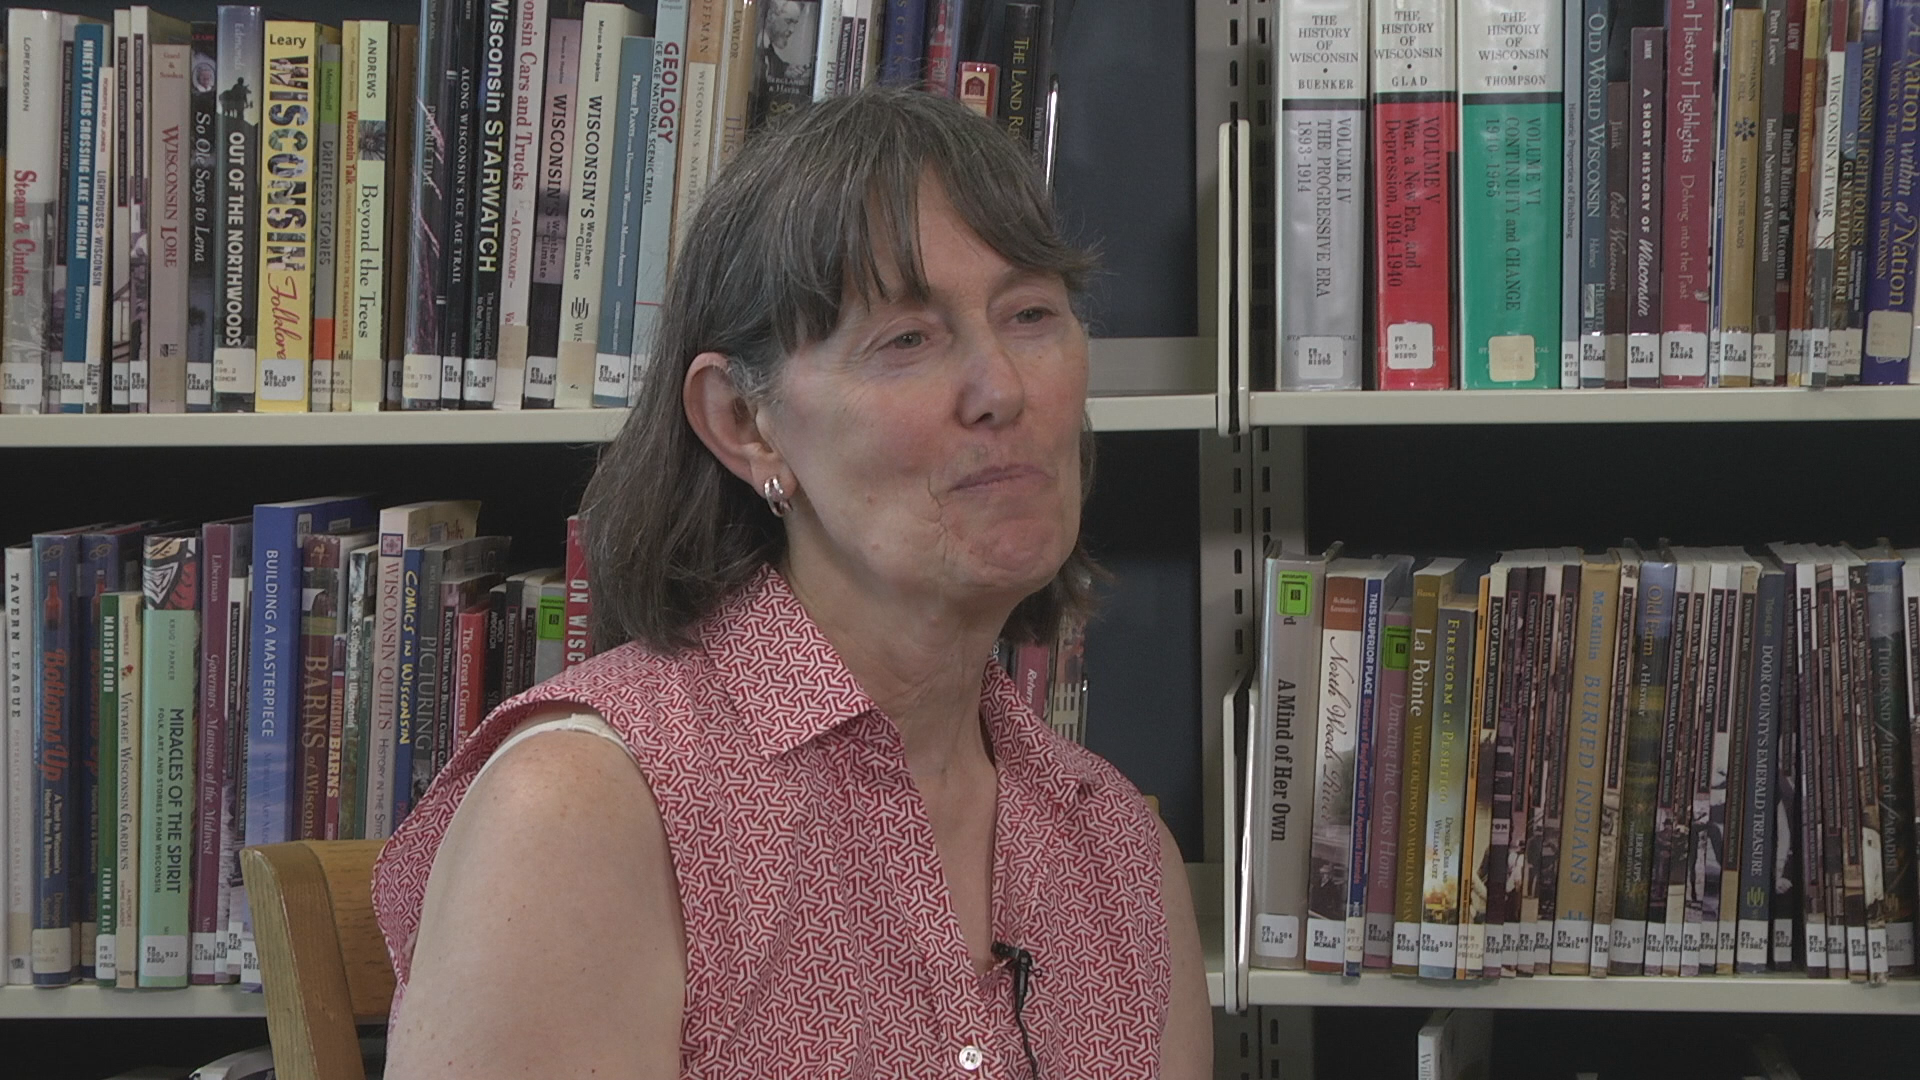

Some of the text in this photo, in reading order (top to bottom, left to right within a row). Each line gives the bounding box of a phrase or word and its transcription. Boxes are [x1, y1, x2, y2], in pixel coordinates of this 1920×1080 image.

[270, 34, 307, 46] Leary
[1289, 53, 1359, 63] WISCONSIN
[1298, 28, 1351, 38] HISTORY
[1311, 15, 1337, 26] THE
[1316, 40, 1333, 50] OF
[1374, 48, 1443, 59] WISCONSIN
[1381, 23, 1434, 34] HISTORY
[1394, 11, 1420, 21] THE
[1399, 36, 1417, 46] OF
[1478, 49, 1549, 60] WISCONSIN
[1487, 24, 1540, 35] HISTORY
[1500, 12, 1527, 23] THE
[1505, 37, 1522, 47] OF
[22, 37, 32, 112] LORENZSONN
[366, 38, 377, 99] ANDREWS
[657, 42, 679, 143] GEOLOGY
[1298, 79, 1354, 89] BUENKER
[1391, 76, 1427, 87] GLAD
[1485, 75, 1546, 86] THOMPSON
[1587, 13, 1606, 217] OLD WORLD WISCONSIN
[75, 40, 95, 259] NINETY YEARS CROSSING LAKE MICHIGAN
[266, 56, 309, 272] WISCONSIN
[512, 51, 537, 190] Cars and Trucks
[580, 95, 602, 218] WISCONSIN'S
[1297, 120, 1312, 193] 1893-1914
[1336, 118, 1351, 204] VOLUME IV
[1422, 116, 1440, 204] VOLUME V
[1525, 117, 1541, 205] VOLUME VI
[1677, 13, 1701, 300] History Highlights Delving into the Past
[1822, 75, 1841, 218] WISCONSIN AT WAR
[161, 125, 179, 267] WISCONSIN LORE
[192, 112, 211, 262] So Ole Says to Lena
[452, 67, 470, 284] ALONG WISCONSIN'S ICE AGE TRAIL
[479, 120, 504, 272] STARWATCH
[1315, 119, 1332, 298] THE PROGRESSIVE ERA
[1382, 119, 1402, 287] Depression, 1914-1940
[1402, 118, 1420, 269] War, a New Era, and
[1504, 116, 1521, 311] CONTINUITY and CHANGE
[1637, 89, 1653, 317] A SHORT HISTORY OF Wisconsin
[11, 170, 37, 296] Steam & Cinders
[226, 132, 244, 346] OUT OF THE NORTHWOODS
[357, 185, 379, 338] Beyond the Trees
[574, 236, 584, 281] Climate
[584, 222, 595, 266] Weather
[74, 286, 84, 320] Brown
[268, 273, 302, 360] Folklore
[211, 554, 222, 602] Liberman
[264, 550, 278, 620] BUILDING
[1588, 591, 1605, 660] McMillin
[9, 573, 21, 718] TAVERN LEAGUE
[104, 616, 114, 692] MADISON FOOD
[263, 624, 276, 635] A
[378, 562, 398, 730] WISCONSIN QUILTS
[399, 570, 417, 744] COMICS IN WISCONSIN
[458, 627, 474, 727] The Great Circus
[1363, 593, 1377, 694] THIS SUPERIOR PLACE
[1410, 628, 1432, 716] La Pointe
[37, 648, 70, 781] Bottoms Up
[261, 638, 276, 737] MASTERPIECE
[303, 655, 328, 770] BARNS of
[415, 635, 437, 750] PICTURING
[1322, 636, 1355, 821] North Woods River
[1438, 619, 1459, 804] FIRESTORM at PESHTIGO
[119, 692, 132, 870] VINTAGE WISCONSIN GARDENS
[166, 708, 184, 894] MIRACLES OF THE SPIRIT
[1270, 679, 1296, 842] A Mind of Her Own
[1570, 675, 1601, 884] BURIED INDIANS
[1751, 645, 1775, 877] DOOR COUNTY'S EMERALD TREASURE
